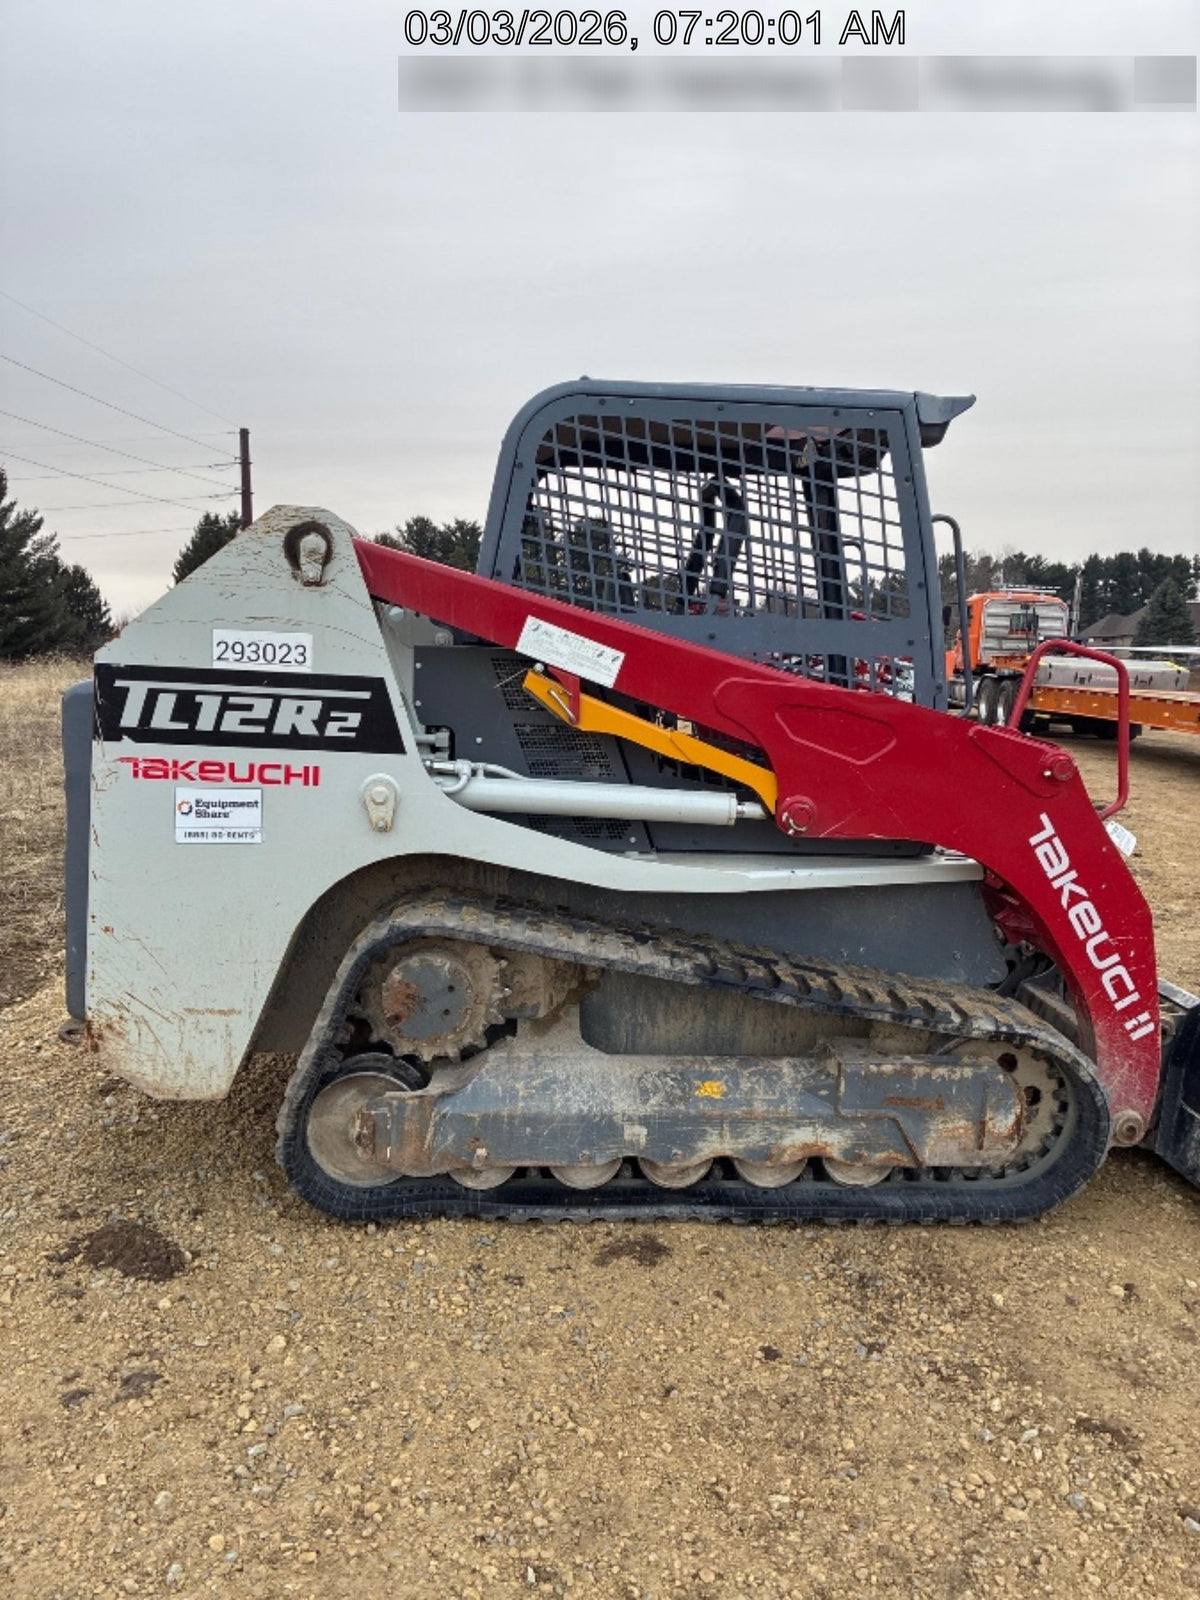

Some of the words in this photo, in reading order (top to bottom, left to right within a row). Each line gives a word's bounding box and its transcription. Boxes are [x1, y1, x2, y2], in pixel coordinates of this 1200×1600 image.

[215, 640, 307, 665] 293023
[195, 798, 259, 809] Equipment
[195, 809, 230, 818] Share
